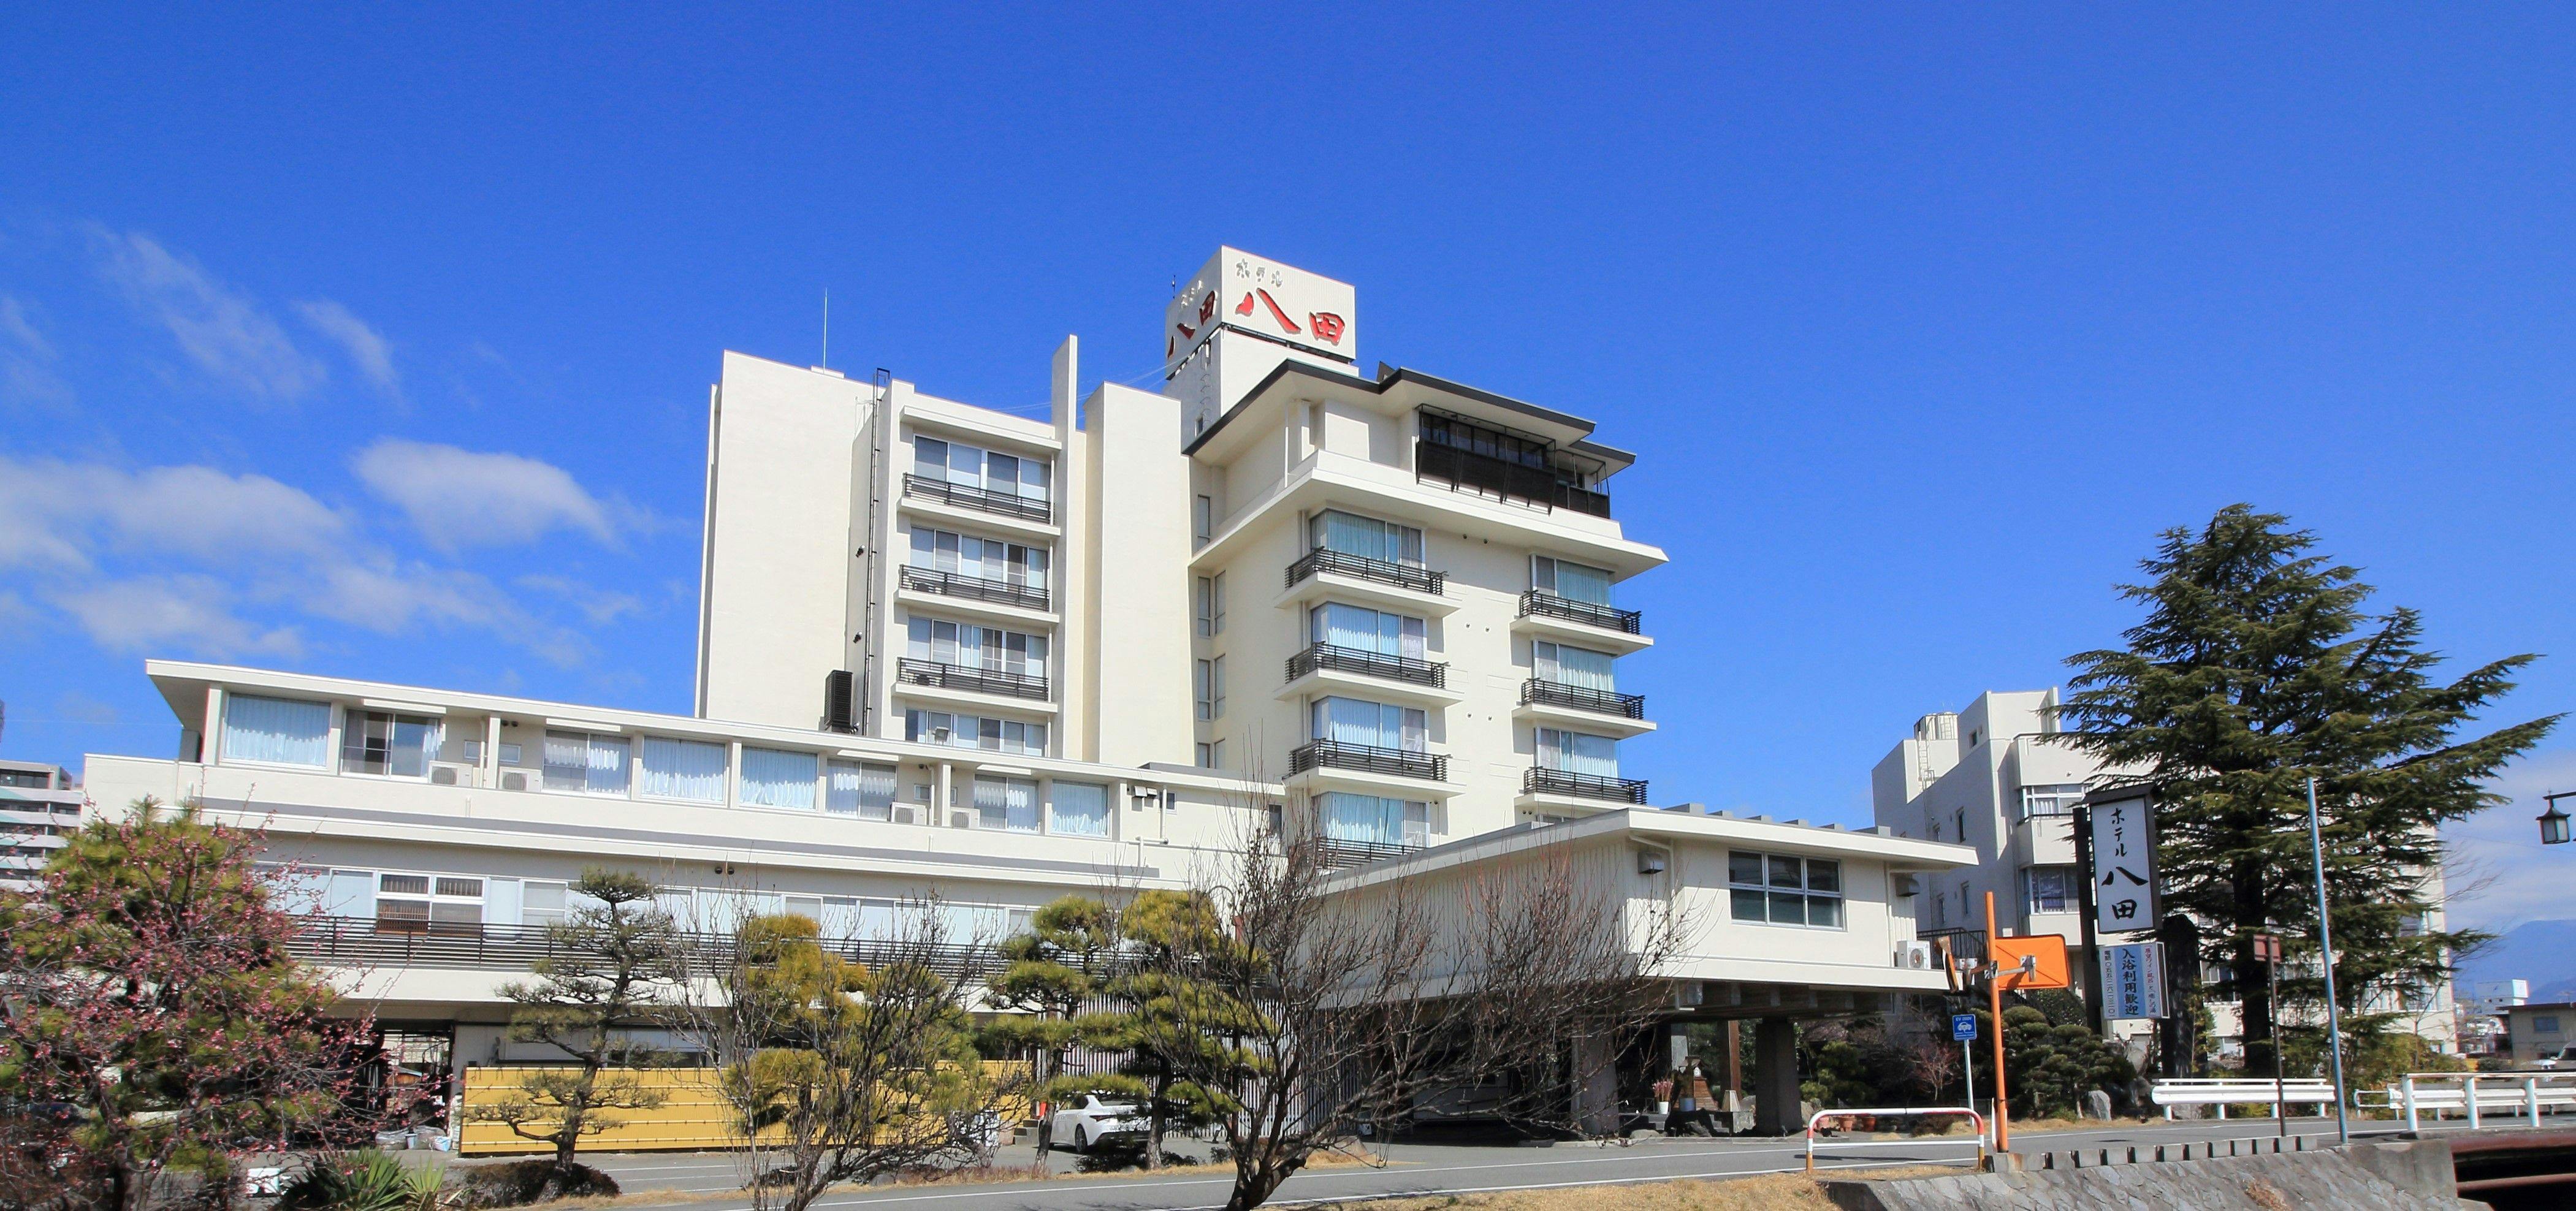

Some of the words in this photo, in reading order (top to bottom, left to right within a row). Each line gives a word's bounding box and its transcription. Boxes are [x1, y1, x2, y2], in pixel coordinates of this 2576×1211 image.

[1235, 287, 1345, 346] 八田
[2122, 948, 2139, 1015] 入浴利用歓迎
